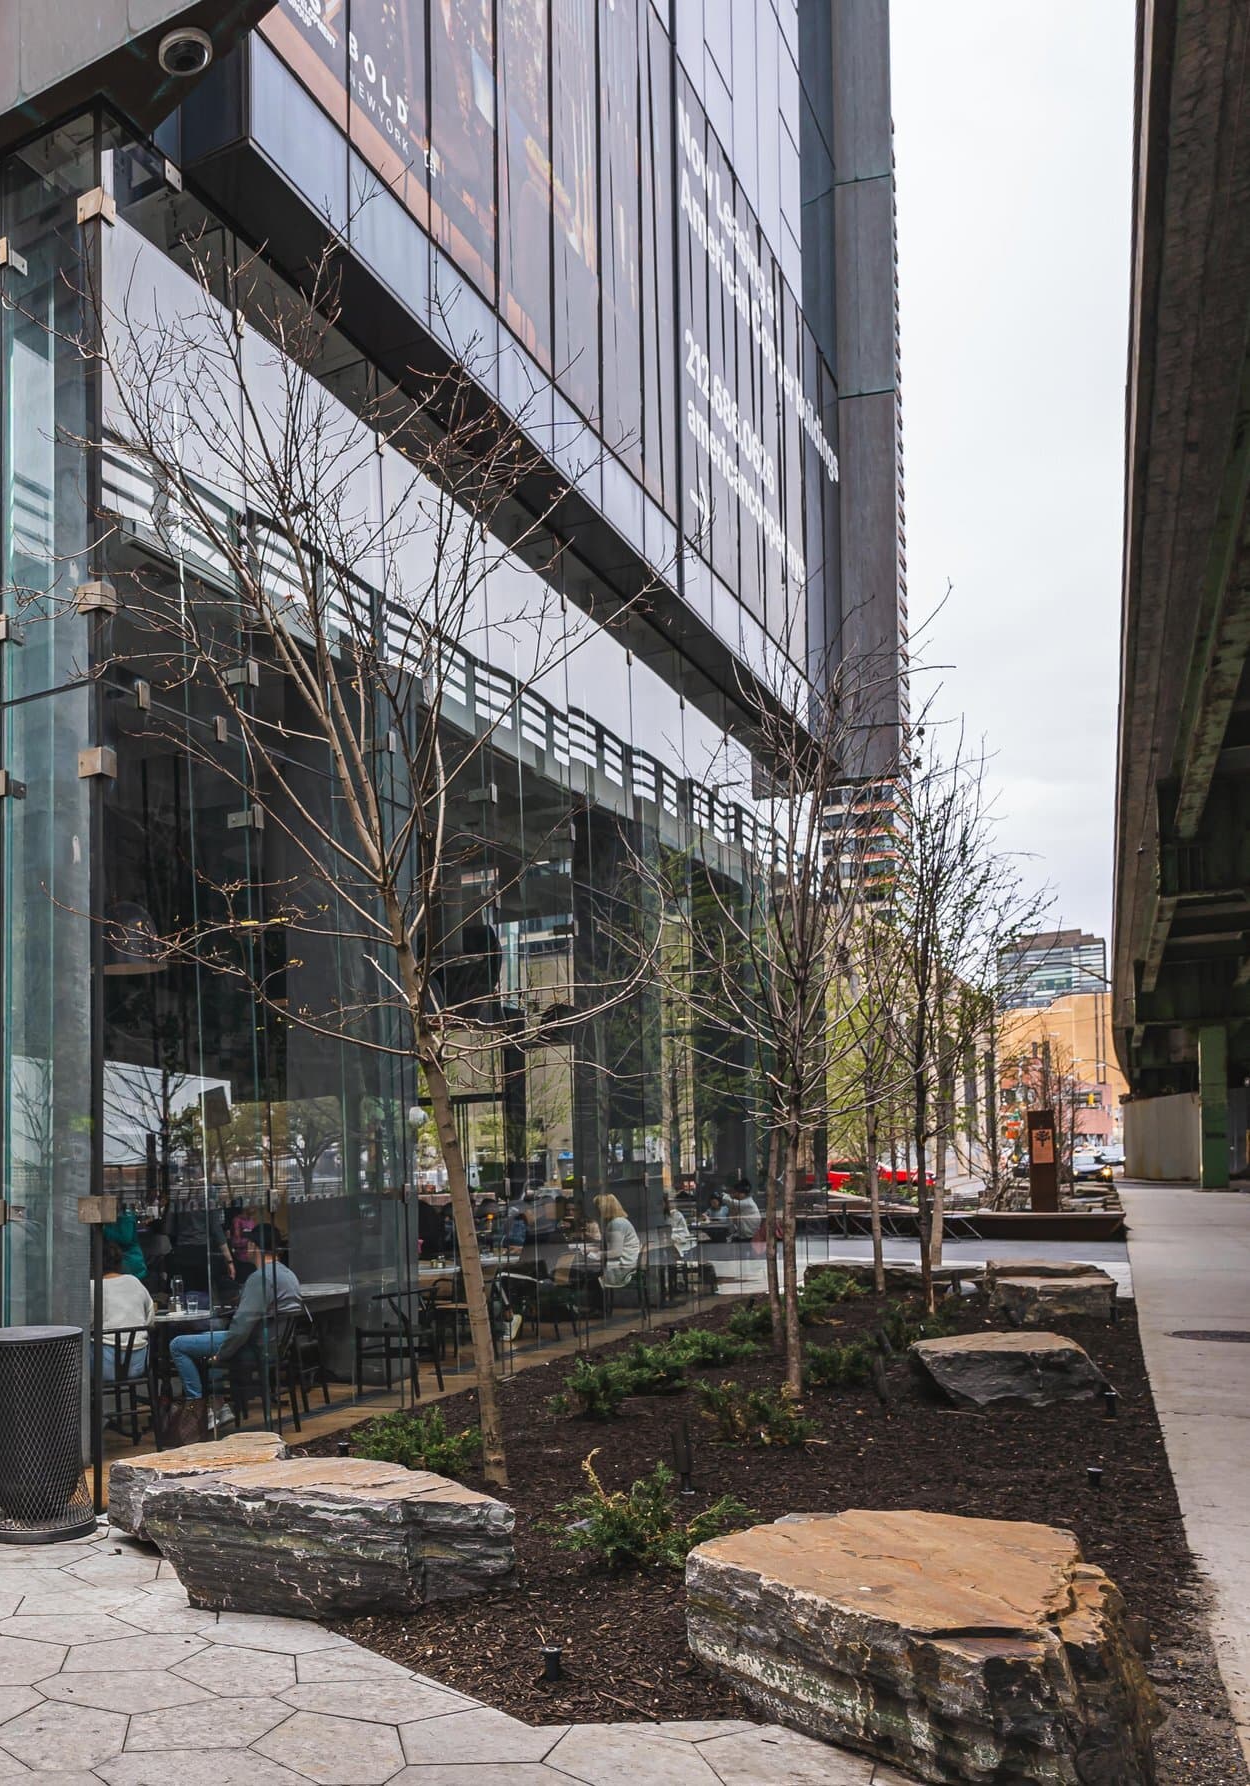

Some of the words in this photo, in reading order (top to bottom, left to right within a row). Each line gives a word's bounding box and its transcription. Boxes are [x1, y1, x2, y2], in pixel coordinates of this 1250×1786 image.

[348, 31, 408, 124] BOLD
[349, 69, 376, 113] NEW
[378, 106, 410, 155] YORK
[677, 96, 714, 201] Now
[714, 170, 766, 311] Leasing
[680, 167, 751, 328] American
[751, 299, 795, 402] Copper
[795, 375, 839, 483] Buildings
[684, 327, 775, 496] 212.686.0626
[687, 398, 807, 586] americancoppernyc
